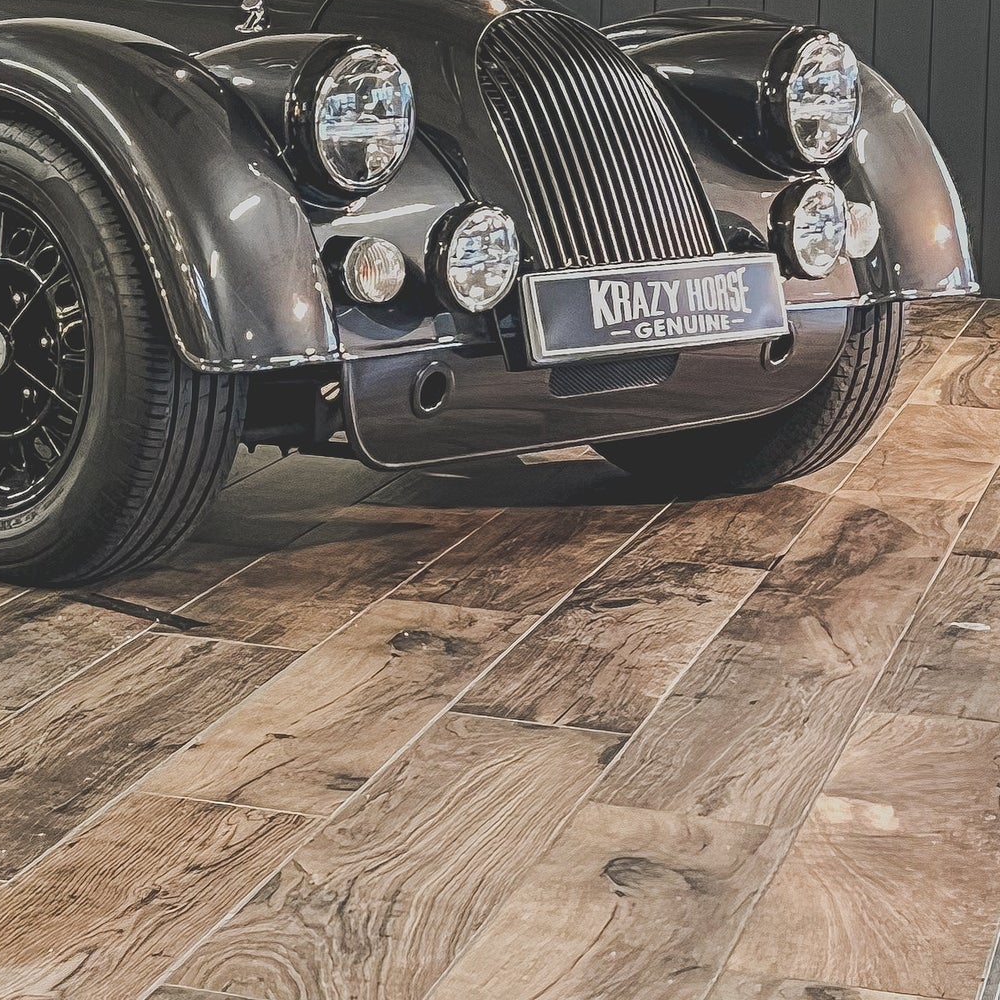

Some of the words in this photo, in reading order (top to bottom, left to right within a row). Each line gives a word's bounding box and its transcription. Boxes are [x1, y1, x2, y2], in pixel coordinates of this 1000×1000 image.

[589, 280, 680, 329] KRAZY
[686, 267, 751, 313] HORSE
[634, 315, 730, 339] GENUINE
